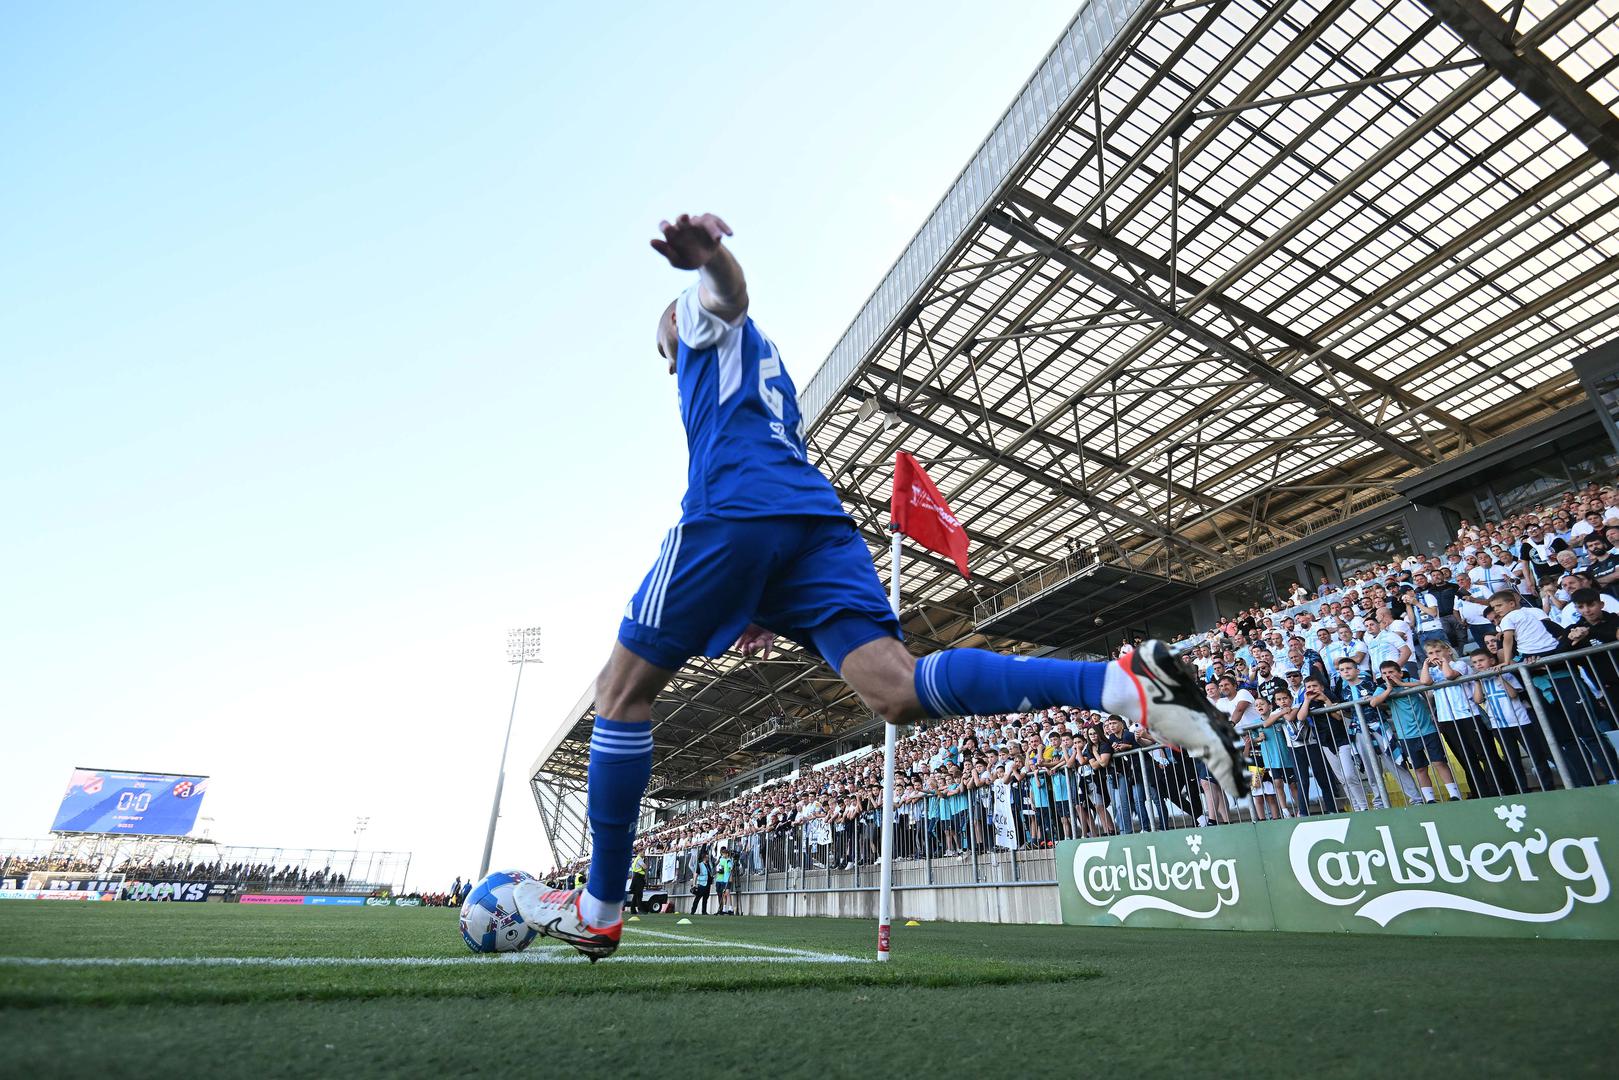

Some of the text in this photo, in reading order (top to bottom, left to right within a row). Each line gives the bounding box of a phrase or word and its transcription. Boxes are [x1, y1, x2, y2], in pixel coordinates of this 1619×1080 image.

[117, 792, 152, 812] 0:0
[1074, 841, 1240, 922] Carlsberg
[1289, 818, 1610, 928] Carlsberg
